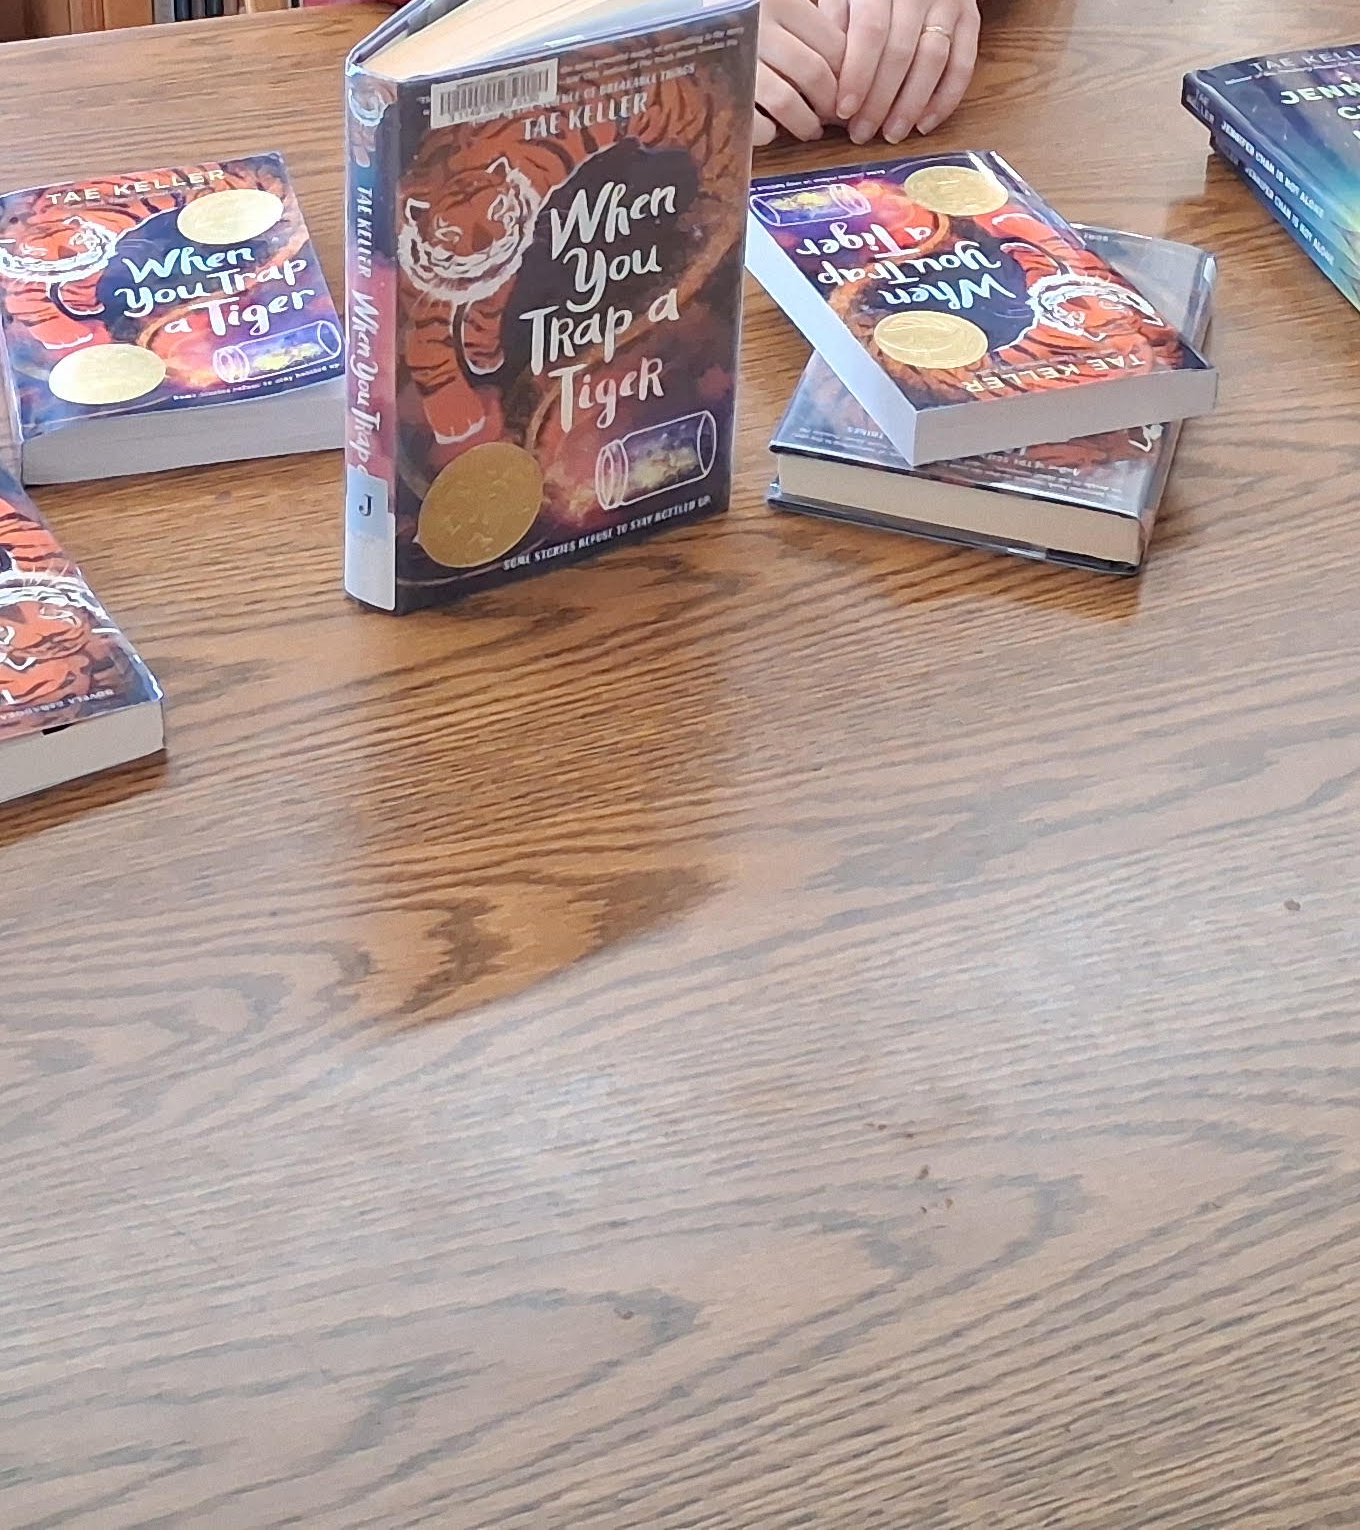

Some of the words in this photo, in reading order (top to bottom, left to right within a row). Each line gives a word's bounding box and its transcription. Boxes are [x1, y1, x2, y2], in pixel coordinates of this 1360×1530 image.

[1250, 58, 1296, 72] TAE
[523, 112, 561, 141] TAE
[569, 92, 649, 131] KELLER
[1221, 121, 1256, 157] JENNIFER
[1255, 151, 1276, 177] CHAN
[46, 189, 101, 205] TAE
[113, 169, 227, 197] KELLER
[356, 186, 373, 214] TAE
[550, 180, 676, 261] When
[916, 223, 933, 240] a
[355, 215, 374, 279] KELLER
[795, 222, 921, 259] Tiger
[917, 240, 1002, 273] You
[122, 245, 256, 284] When
[561, 245, 662, 314] You
[817, 258, 921, 287] Trap
[114, 283, 211, 318] You
[206, 258, 309, 296] Trap
[649, 288, 680, 323] a
[878, 273, 1016, 310] When
[164, 317, 191, 336] a
[189, 286, 317, 338] Tiger
[349, 350, 380, 406] You
[962, 363, 1082, 395] KELLER
[1091, 355, 1146, 372] TAE
[358, 494, 372, 517] J
